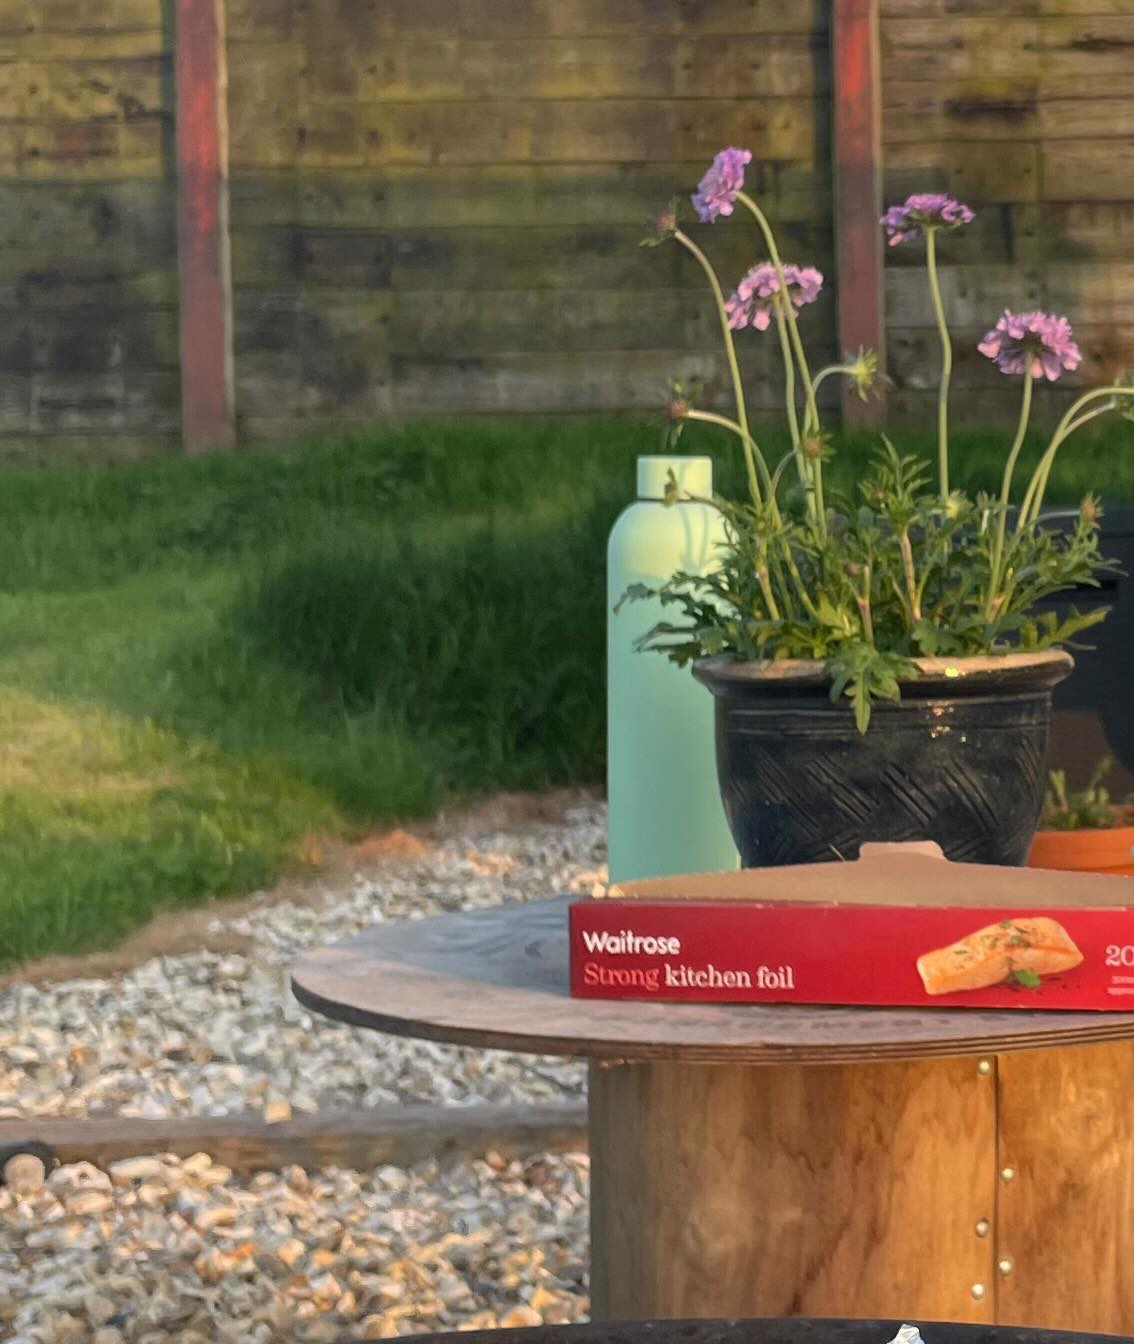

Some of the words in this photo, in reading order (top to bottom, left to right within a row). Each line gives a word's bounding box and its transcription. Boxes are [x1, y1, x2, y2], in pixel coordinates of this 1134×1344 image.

[582, 929, 680, 955] Waitrose
[584, 962, 659, 991] Strong
[664, 963, 752, 988] kitchen
[757, 965, 795, 989] foil
